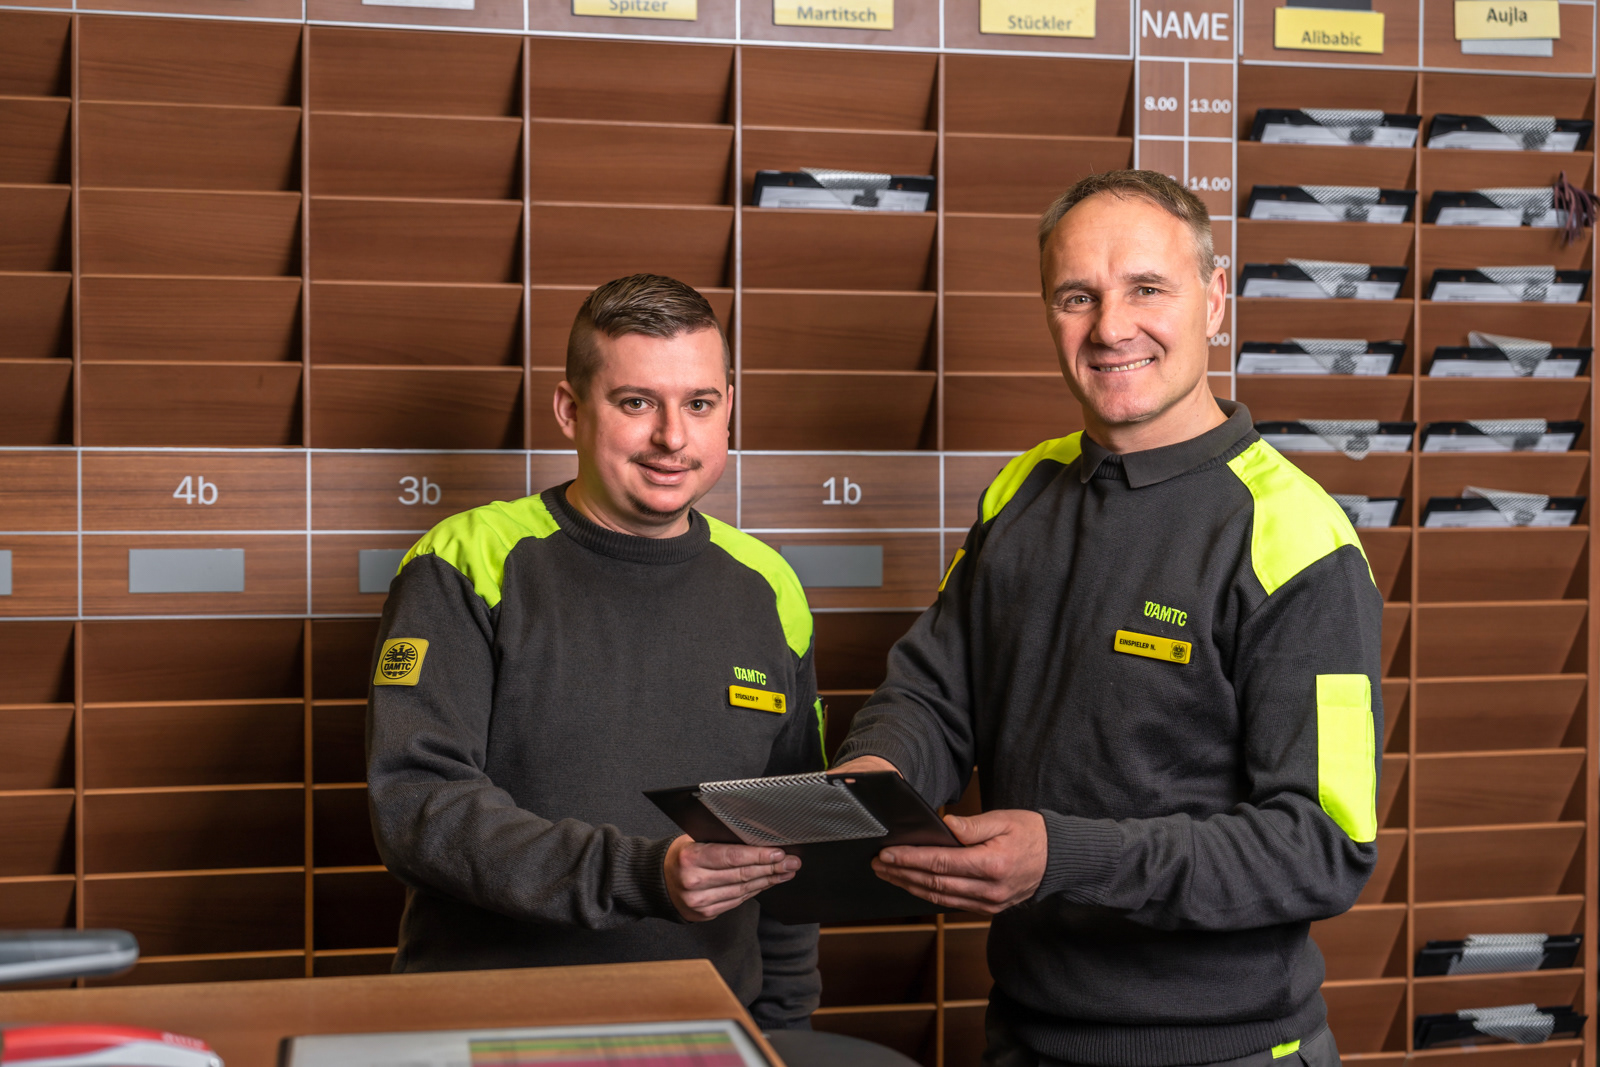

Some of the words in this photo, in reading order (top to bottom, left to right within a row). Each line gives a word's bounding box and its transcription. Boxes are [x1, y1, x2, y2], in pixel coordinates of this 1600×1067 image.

[609, 0, 668, 13] Spitzer
[797, 6, 877, 22] Martitsch
[1007, 14, 1073, 31] Stückler
[1141, 9, 1229, 41] NAME
[1486, 7, 1528, 26] Aujla
[1301, 30, 1362, 47] Alibabic
[1144, 96, 1178, 112] 8.00
[1190, 98, 1232, 114] 13.00
[1190, 176, 1231, 192] 14.00
[172, 475, 219, 506] 4b
[398, 476, 442, 506] 3b
[822, 476, 862, 505] 1b
[1119, 638, 1150, 649] EINSPIELER
